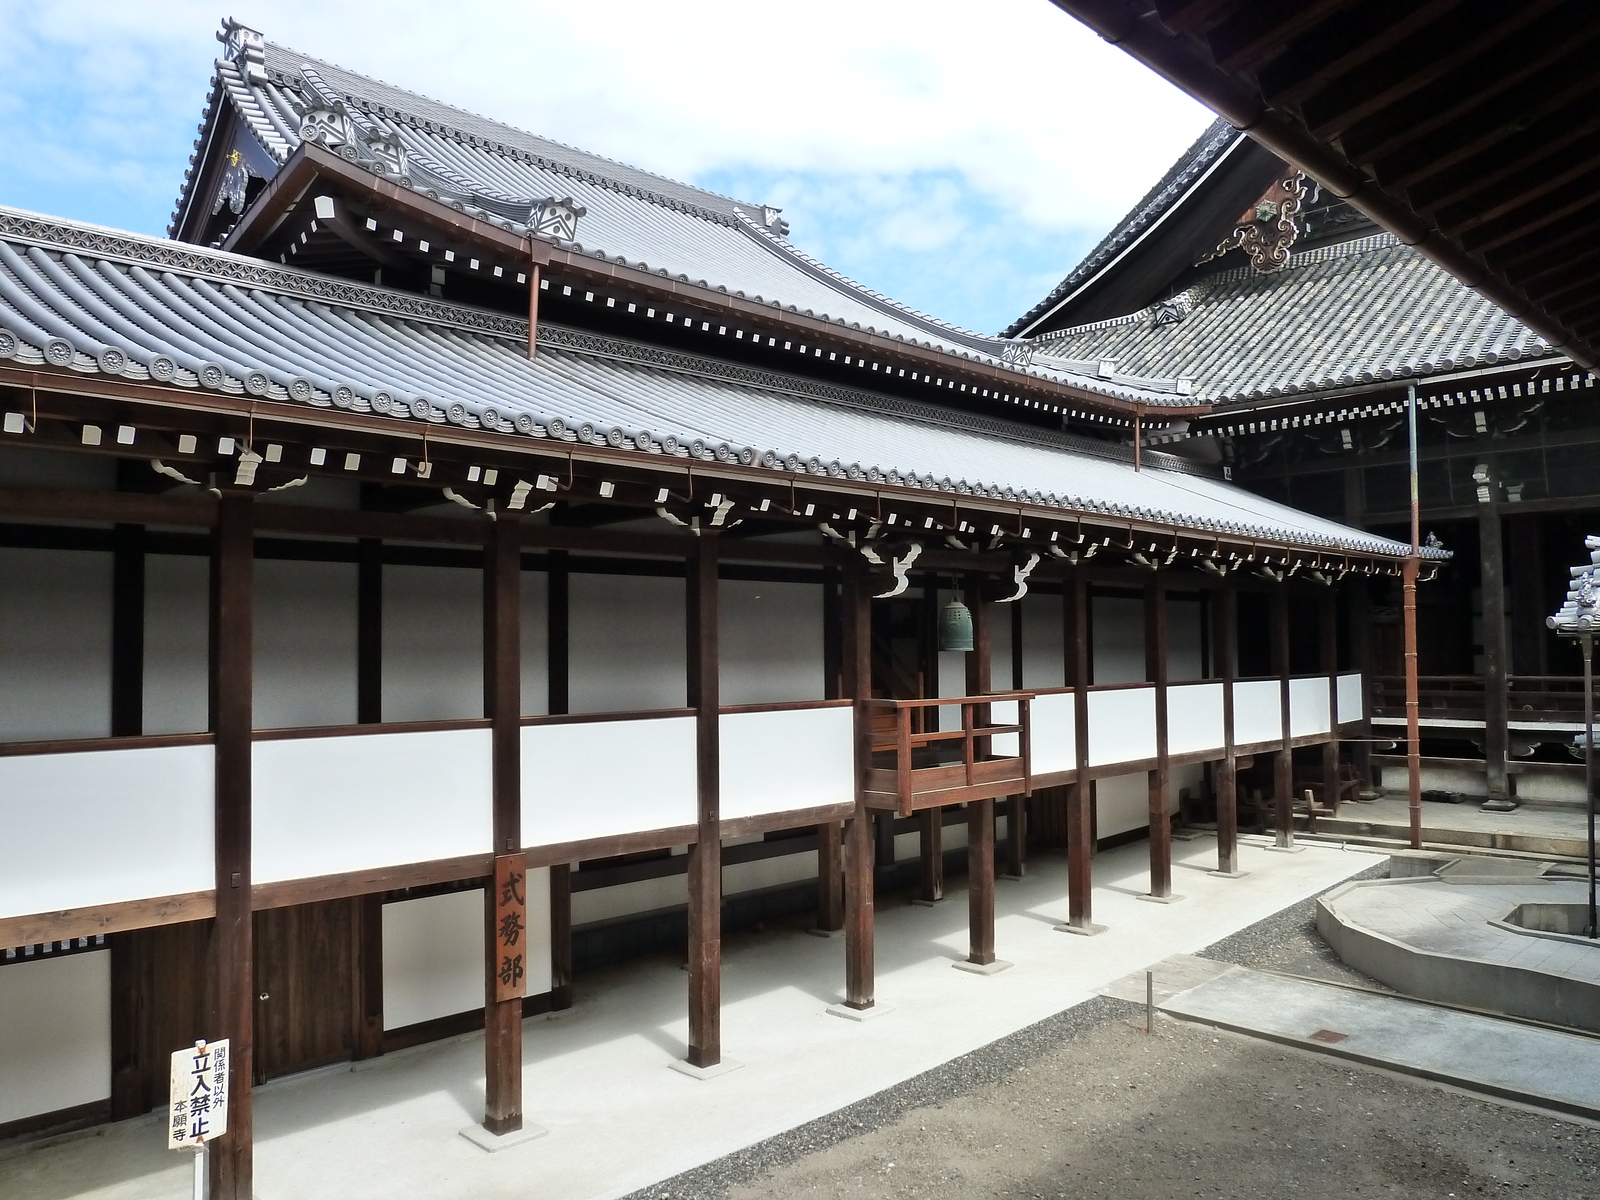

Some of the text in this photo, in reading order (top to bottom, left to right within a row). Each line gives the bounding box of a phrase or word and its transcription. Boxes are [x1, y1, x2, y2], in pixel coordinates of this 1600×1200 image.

[498, 872, 524, 988] 式務部
[189, 1051, 211, 1138] 立入禁止
[213, 1047, 226, 1108] 関係者以外
[172, 1100, 188, 1142] 本願寺
